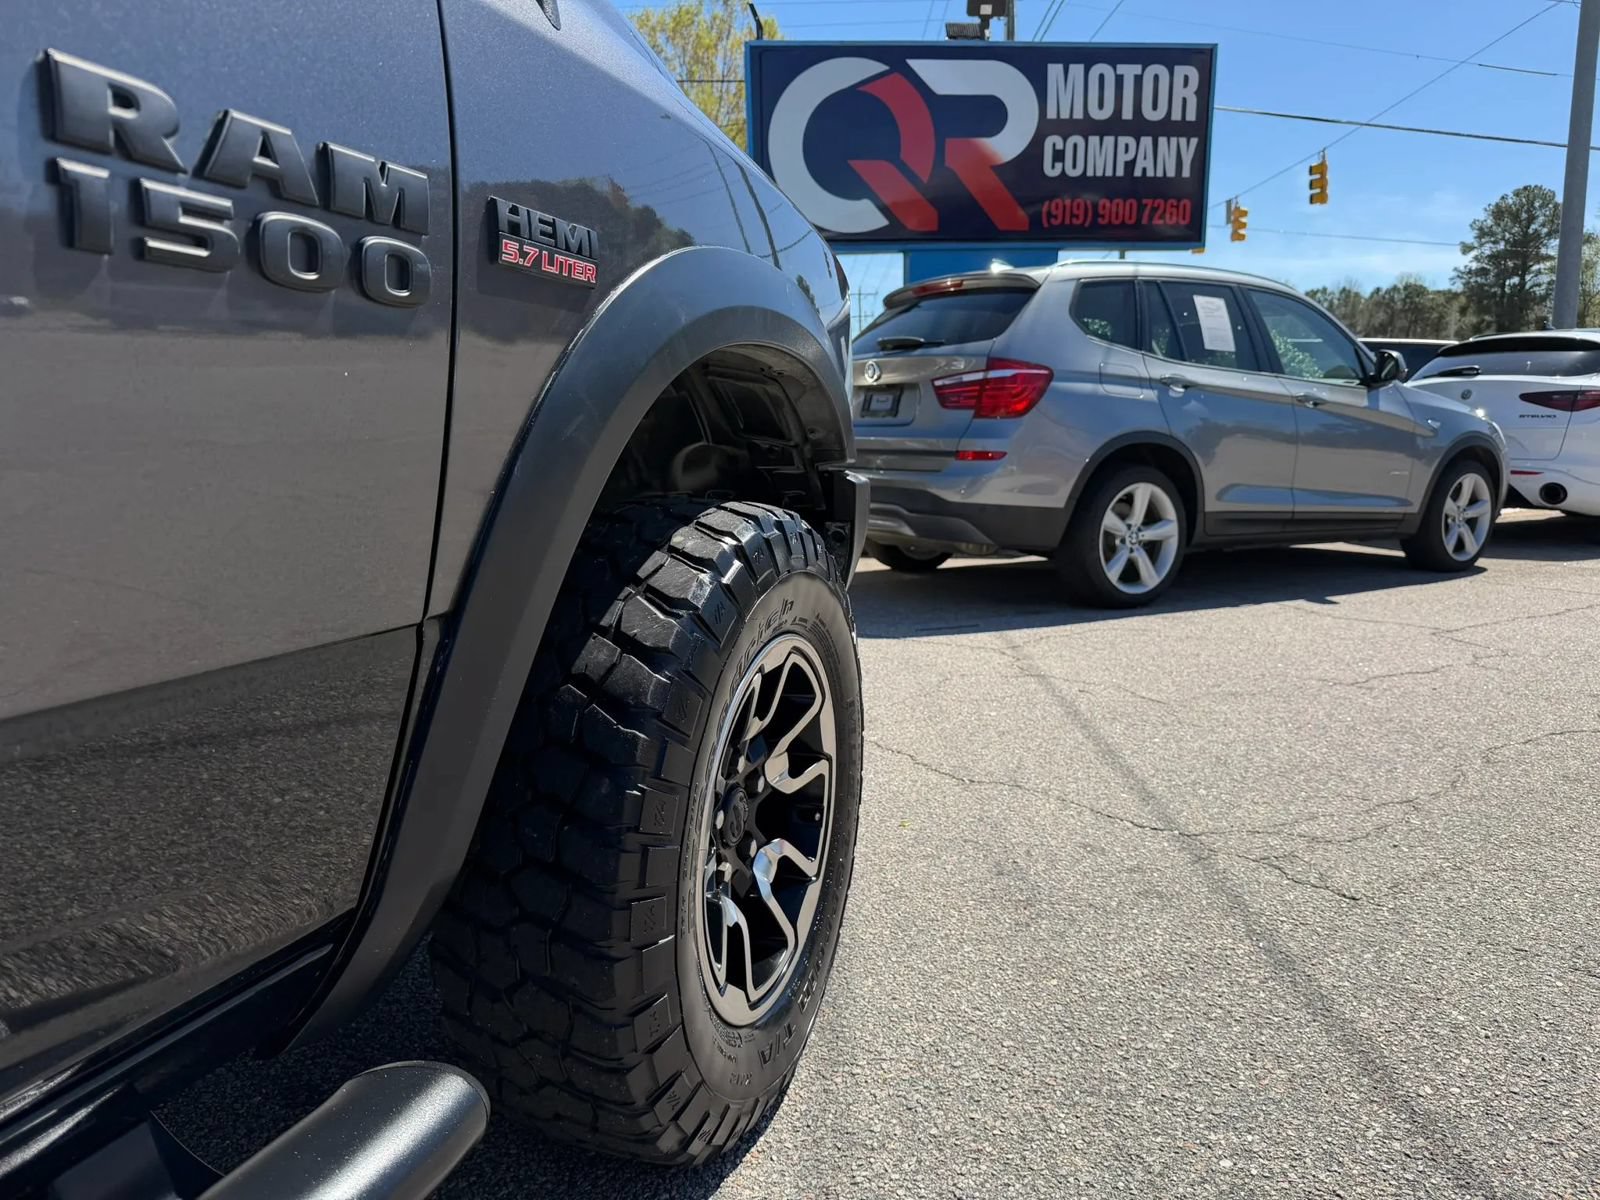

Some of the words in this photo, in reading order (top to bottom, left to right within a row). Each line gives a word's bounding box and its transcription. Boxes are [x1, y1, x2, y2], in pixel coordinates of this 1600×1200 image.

[1046, 63, 1199, 121] MOTOR
[42, 48, 430, 235] RAM
[768, 57, 1039, 233] QR
[1043, 135, 1199, 178] COMPANY
[54, 157, 431, 307] 1500
[490, 195, 599, 259] HEMI
[1041, 198, 1094, 228] (919)
[1097, 198, 1138, 225] 900
[1141, 199, 1192, 225] 7260
[501, 238, 540, 267] 5.7
[541, 250, 596, 283] LITER
